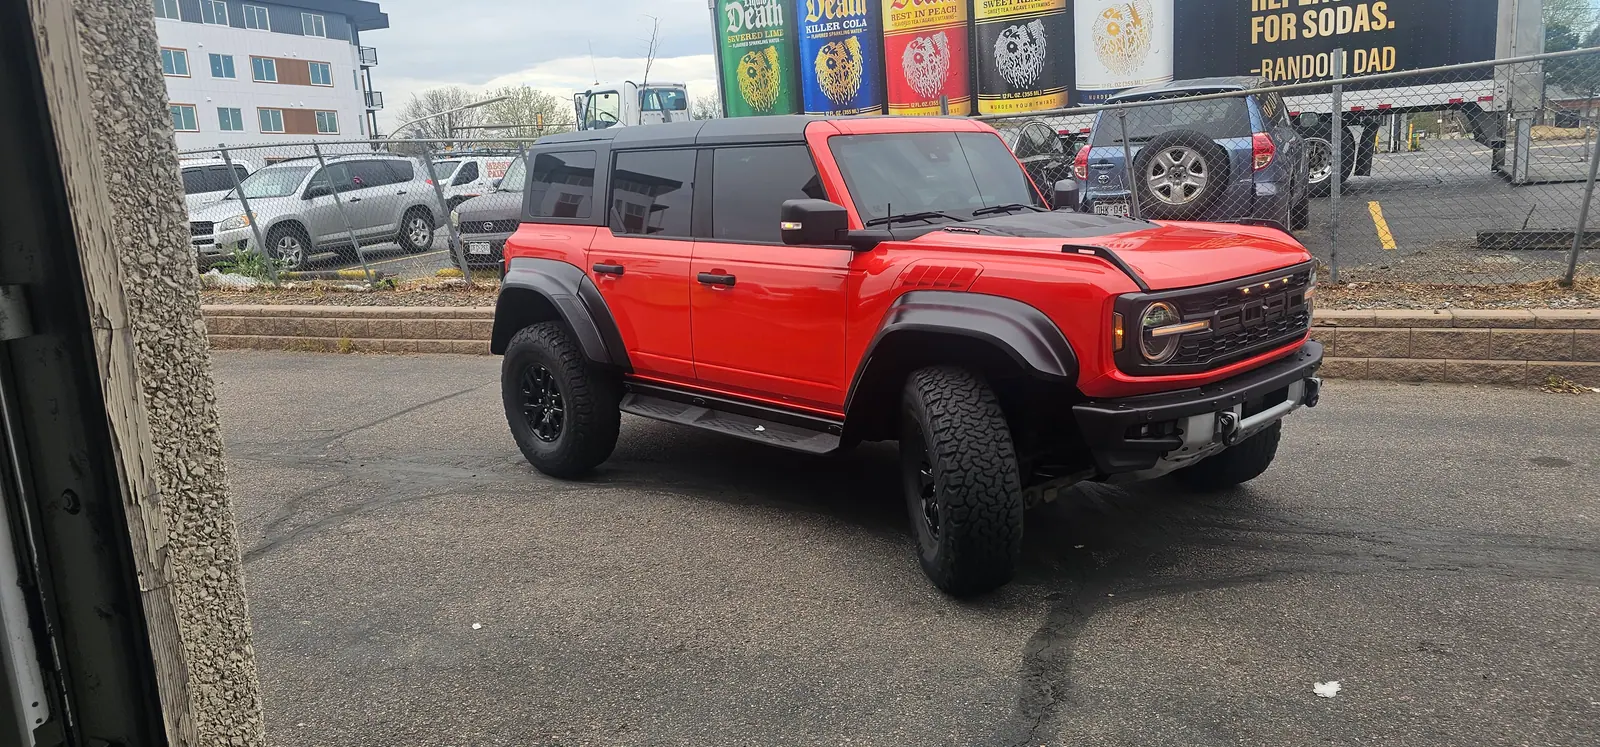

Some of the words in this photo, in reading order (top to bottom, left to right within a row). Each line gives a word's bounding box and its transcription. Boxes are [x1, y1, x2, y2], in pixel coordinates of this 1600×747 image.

[725, 0, 783, 33] Death
[805, 21, 841, 34] KILLER
[843, 18, 867, 29] COLA
[891, 11, 912, 21] REST
[914, 10, 926, 18] IN
[928, 5, 957, 16] PEACH
[1251, 12, 1297, 45] FOR
[1302, 1, 1396, 39] SODAS.
[727, 31, 764, 44] SEVERED
[765, 29, 784, 38] LIME
[1353, 46, 1396, 74] DAD
[1212, 286, 1306, 337] FORD
